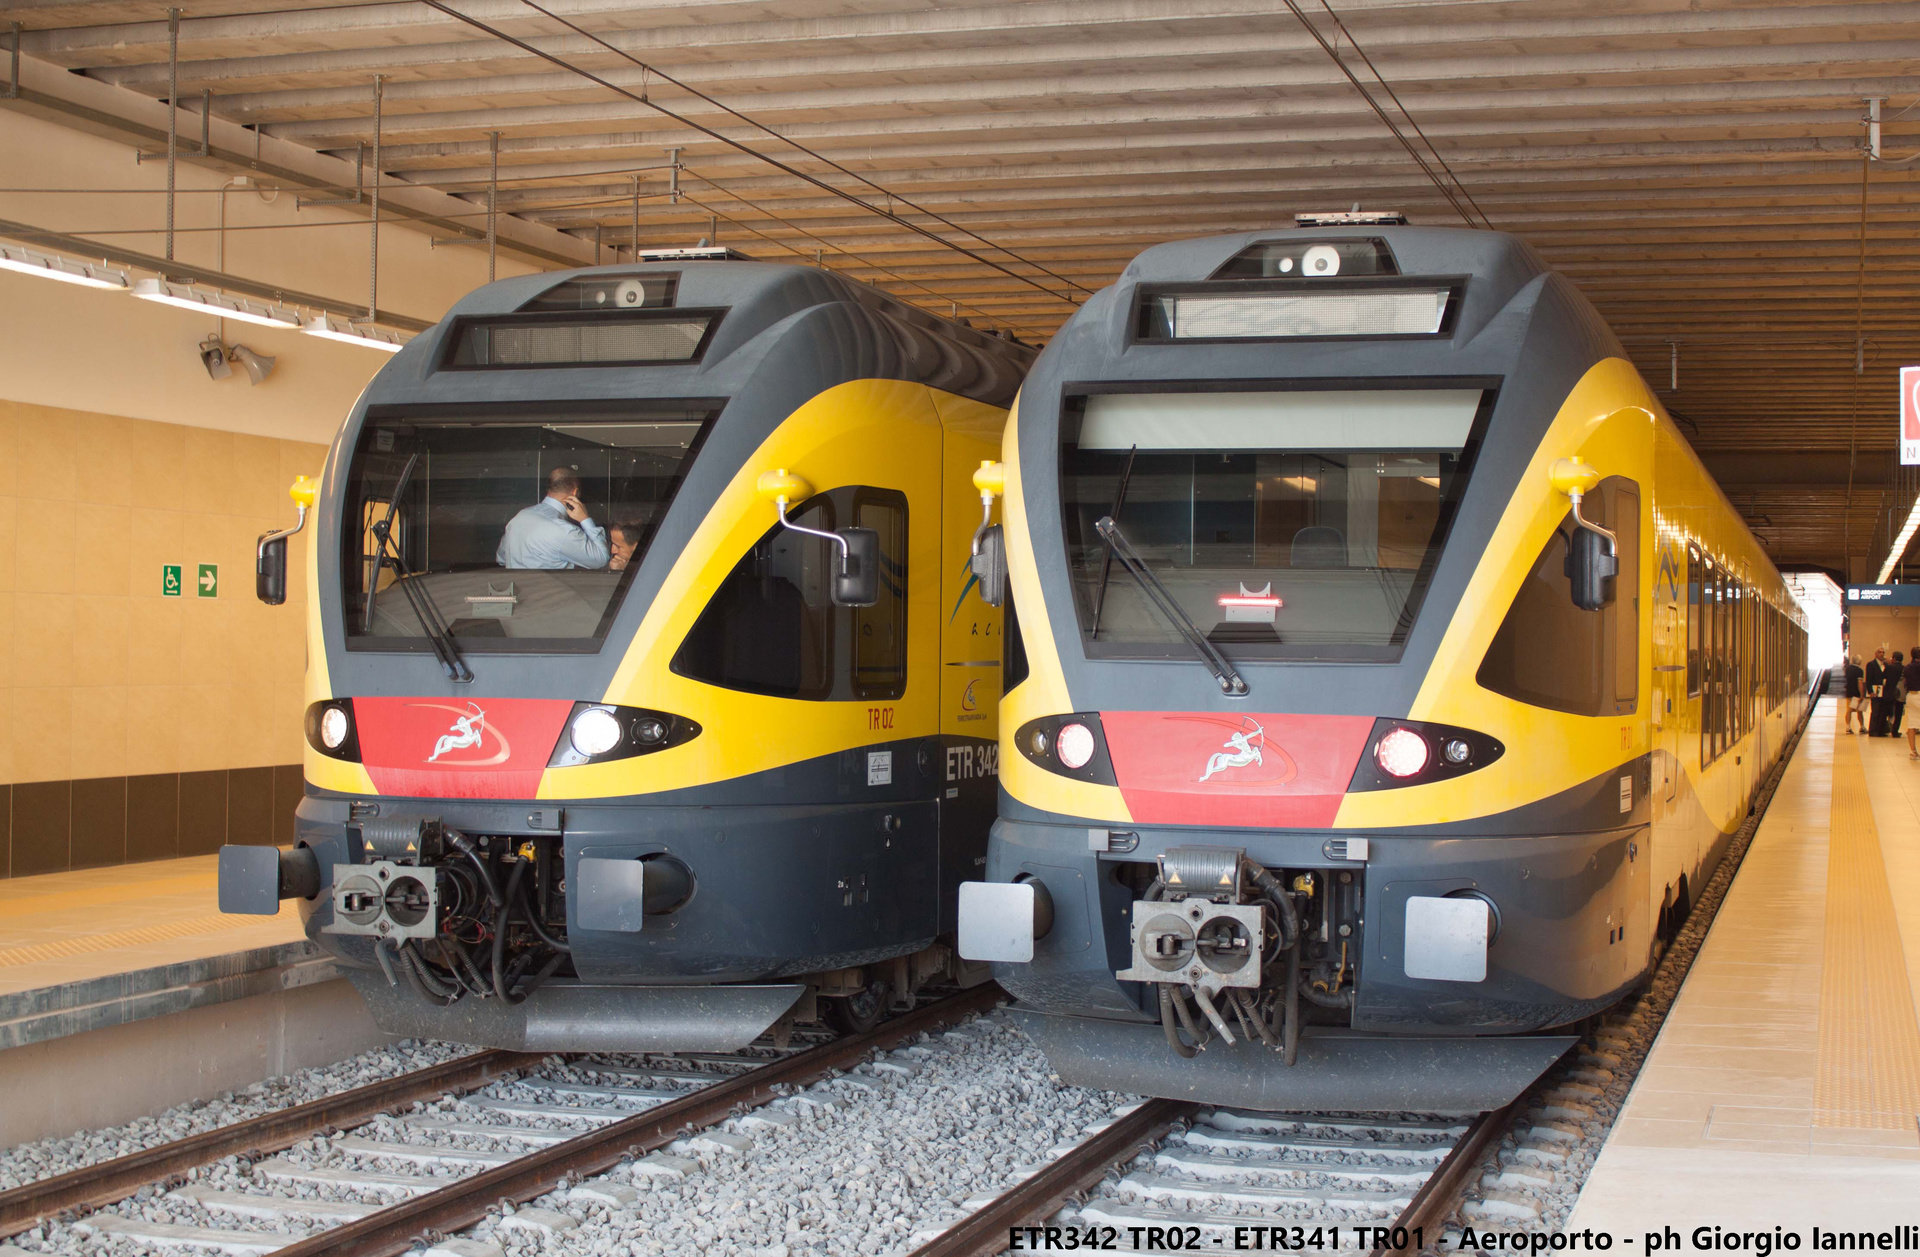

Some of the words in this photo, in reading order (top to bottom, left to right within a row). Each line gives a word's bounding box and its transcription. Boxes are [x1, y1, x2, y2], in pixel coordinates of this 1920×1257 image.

[868, 709, 880, 731] TR
[882, 707, 894, 730] 02
[946, 748, 974, 782] ETR
[977, 744, 999, 778] 342
